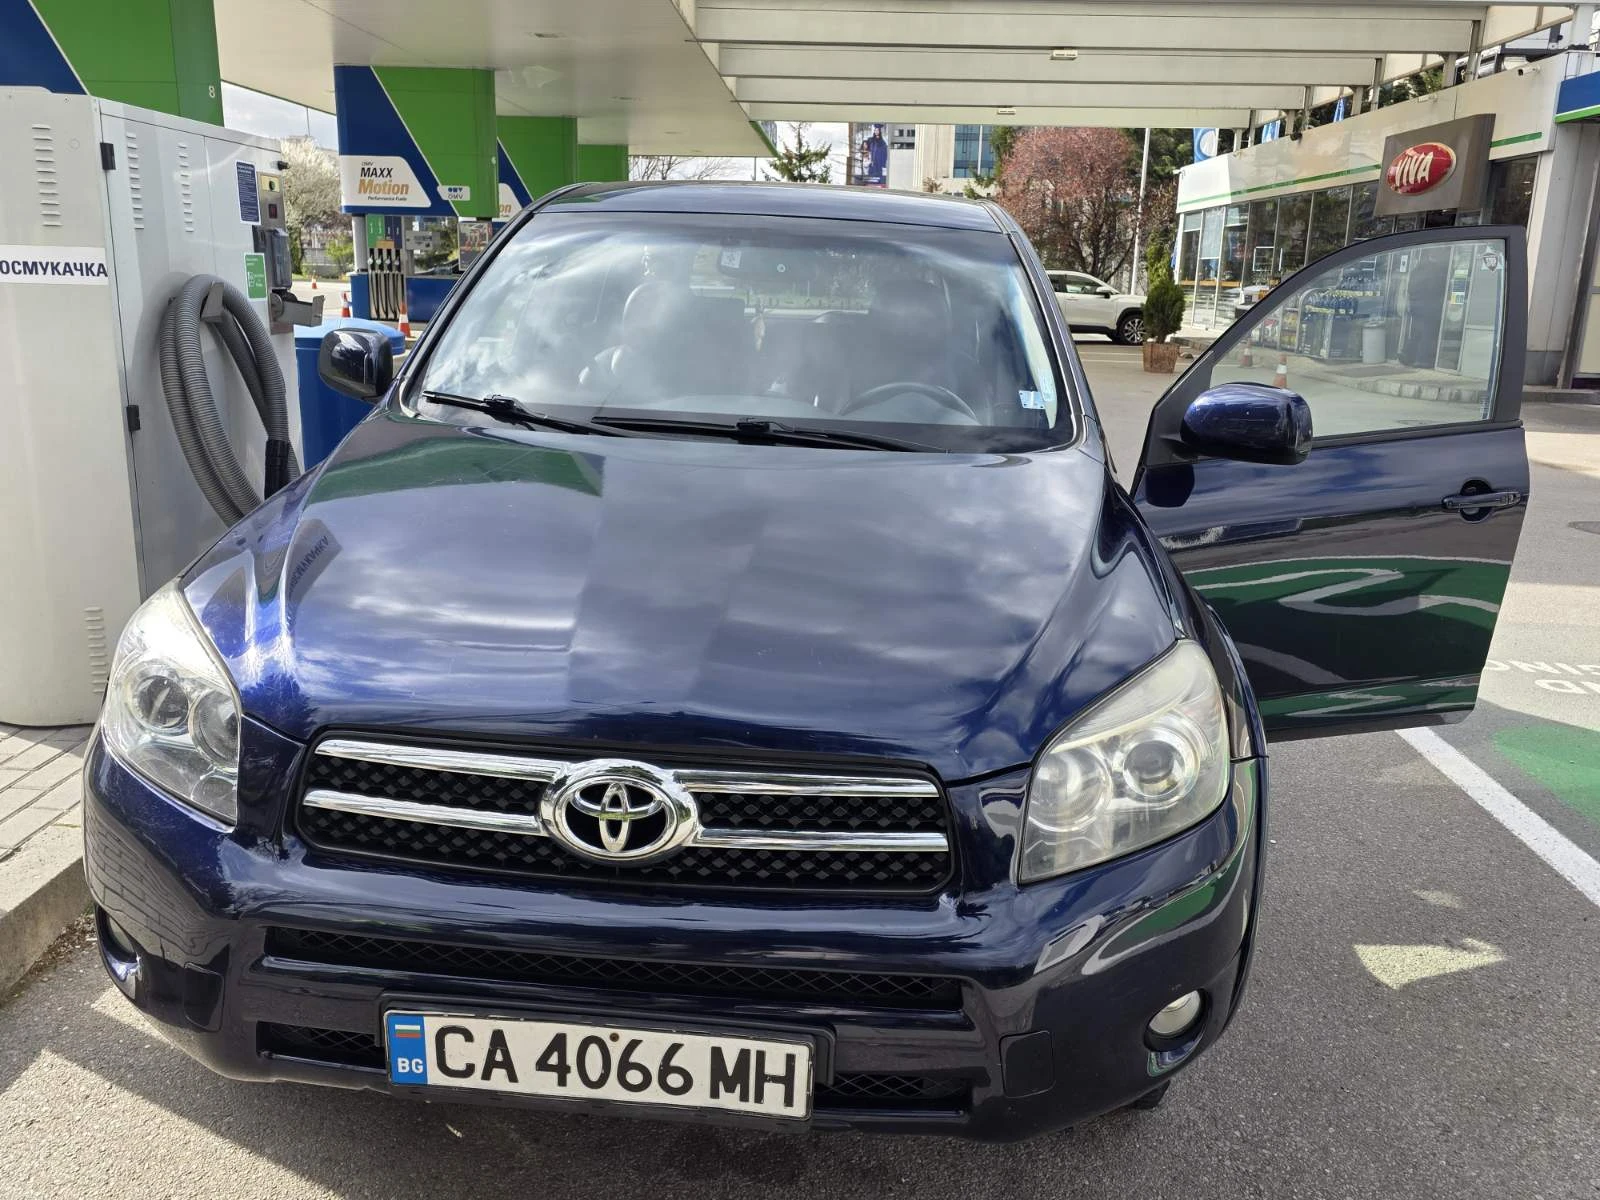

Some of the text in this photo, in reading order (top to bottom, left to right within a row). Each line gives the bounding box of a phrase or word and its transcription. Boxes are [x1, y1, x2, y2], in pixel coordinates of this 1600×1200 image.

[208, 85, 216, 98] 8
[360, 167, 394, 178] MAXX
[1394, 151, 1434, 188] VIVA
[358, 179, 410, 195] Motion
[0, 259, 109, 278] ОСМУКАЧКА
[397, 1057, 424, 1073] BG
[435, 1025, 796, 1107] CA 4066 MH
